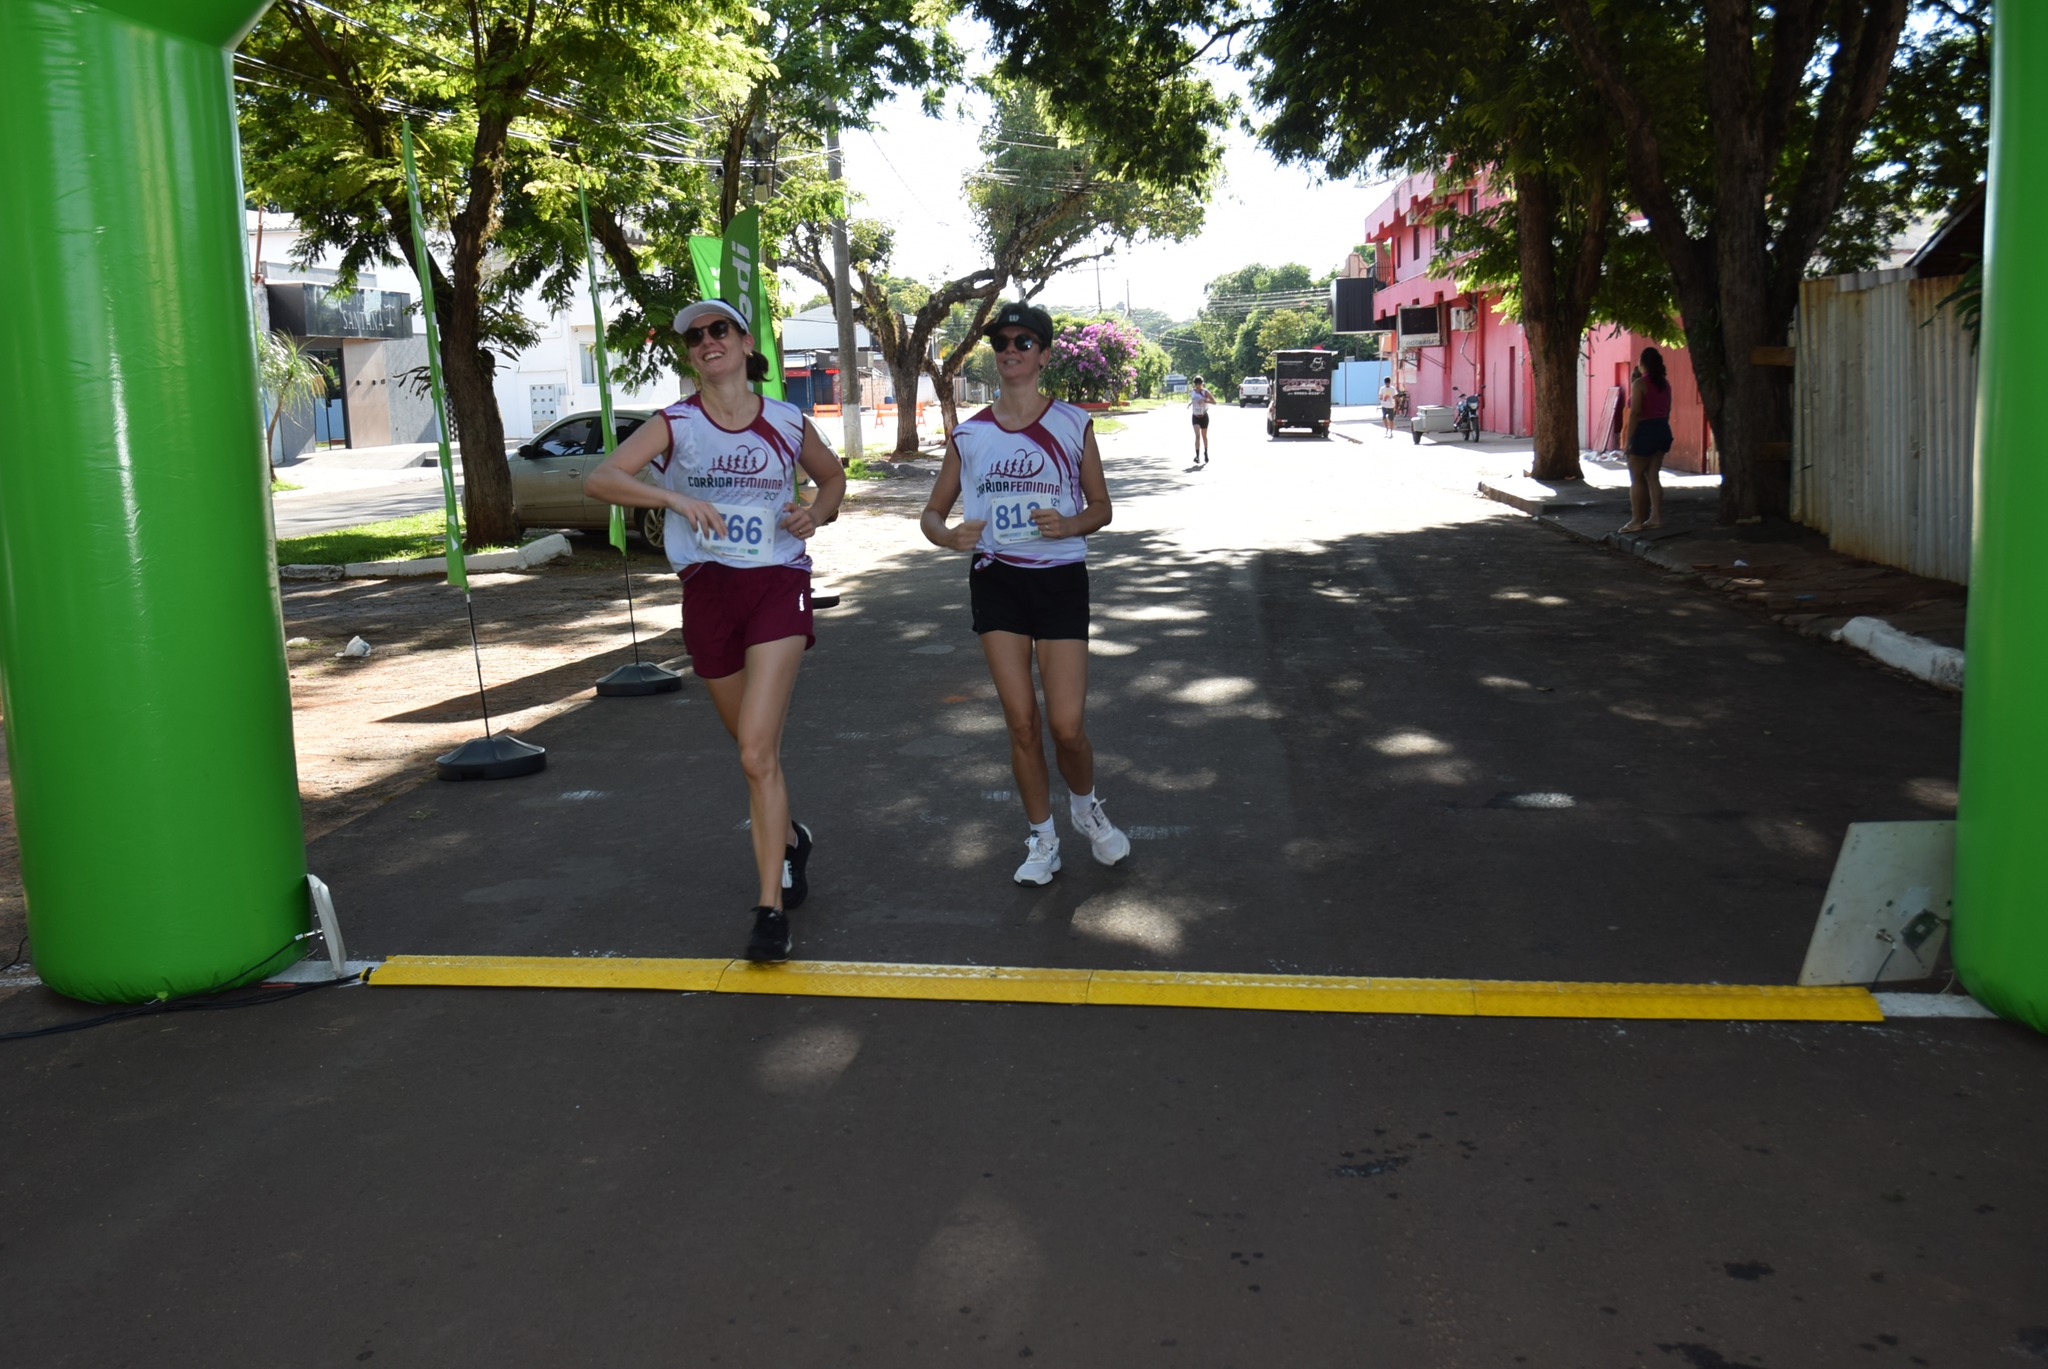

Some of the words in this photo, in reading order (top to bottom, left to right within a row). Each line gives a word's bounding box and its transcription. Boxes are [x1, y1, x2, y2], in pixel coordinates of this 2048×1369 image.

[688, 476, 732, 488] CORRIDA
[734, 477, 783, 490] FEMININA
[1011, 481, 1060, 496] FEMININA
